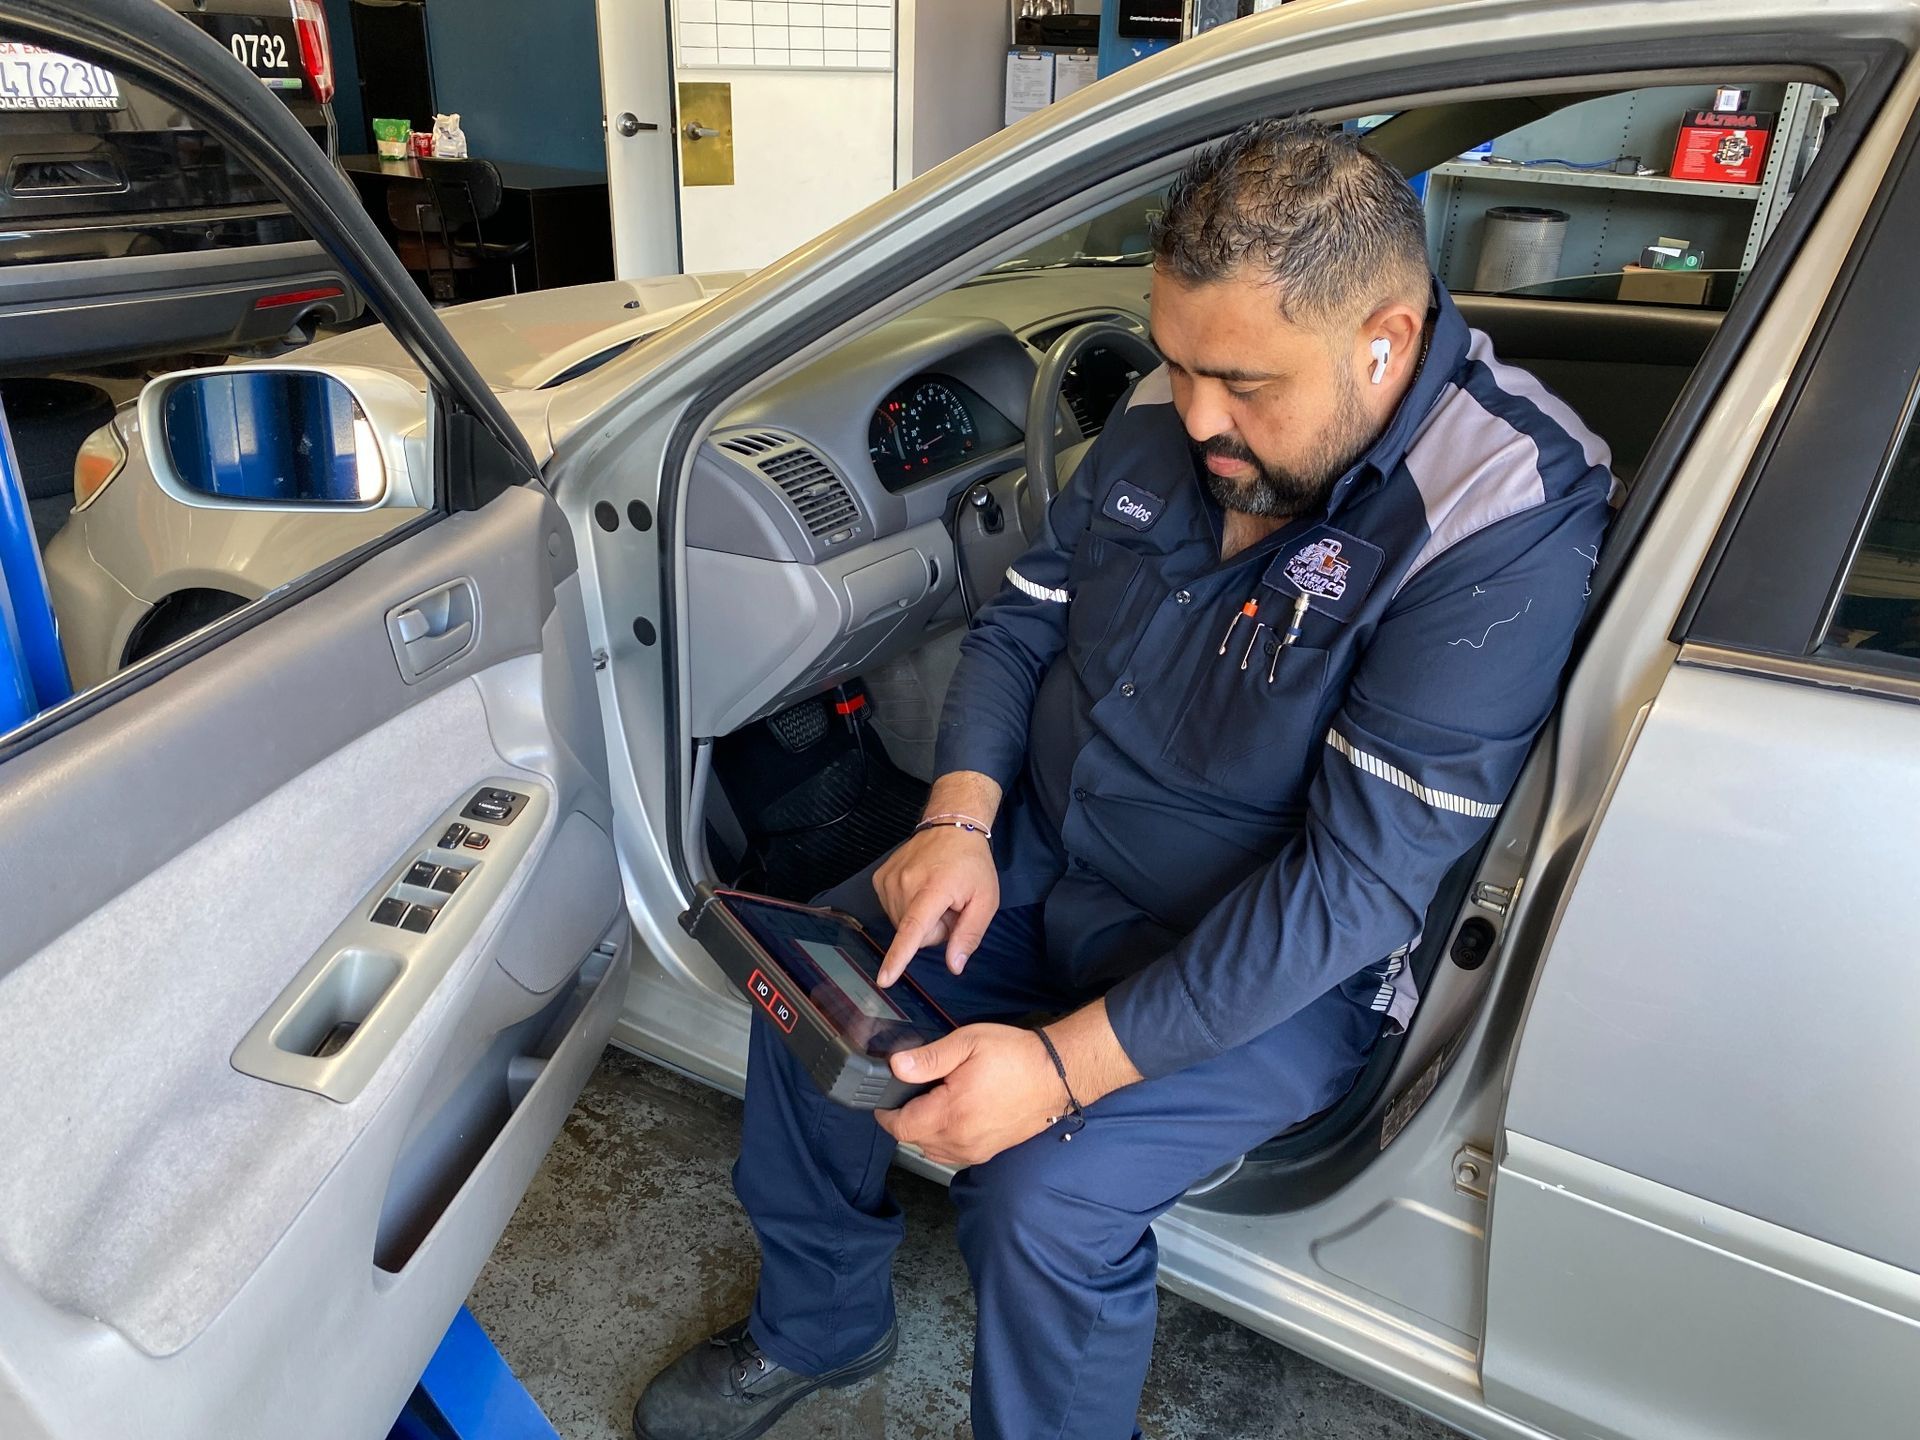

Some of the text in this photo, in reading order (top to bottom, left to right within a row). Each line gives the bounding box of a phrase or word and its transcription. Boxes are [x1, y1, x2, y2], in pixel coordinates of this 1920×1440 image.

[0, 43, 17, 54] CA
[231, 33, 288, 68] 0732
[0, 97, 119, 108] OLICE DEPARTMENT
[1116, 495, 1152, 522] Carlos
